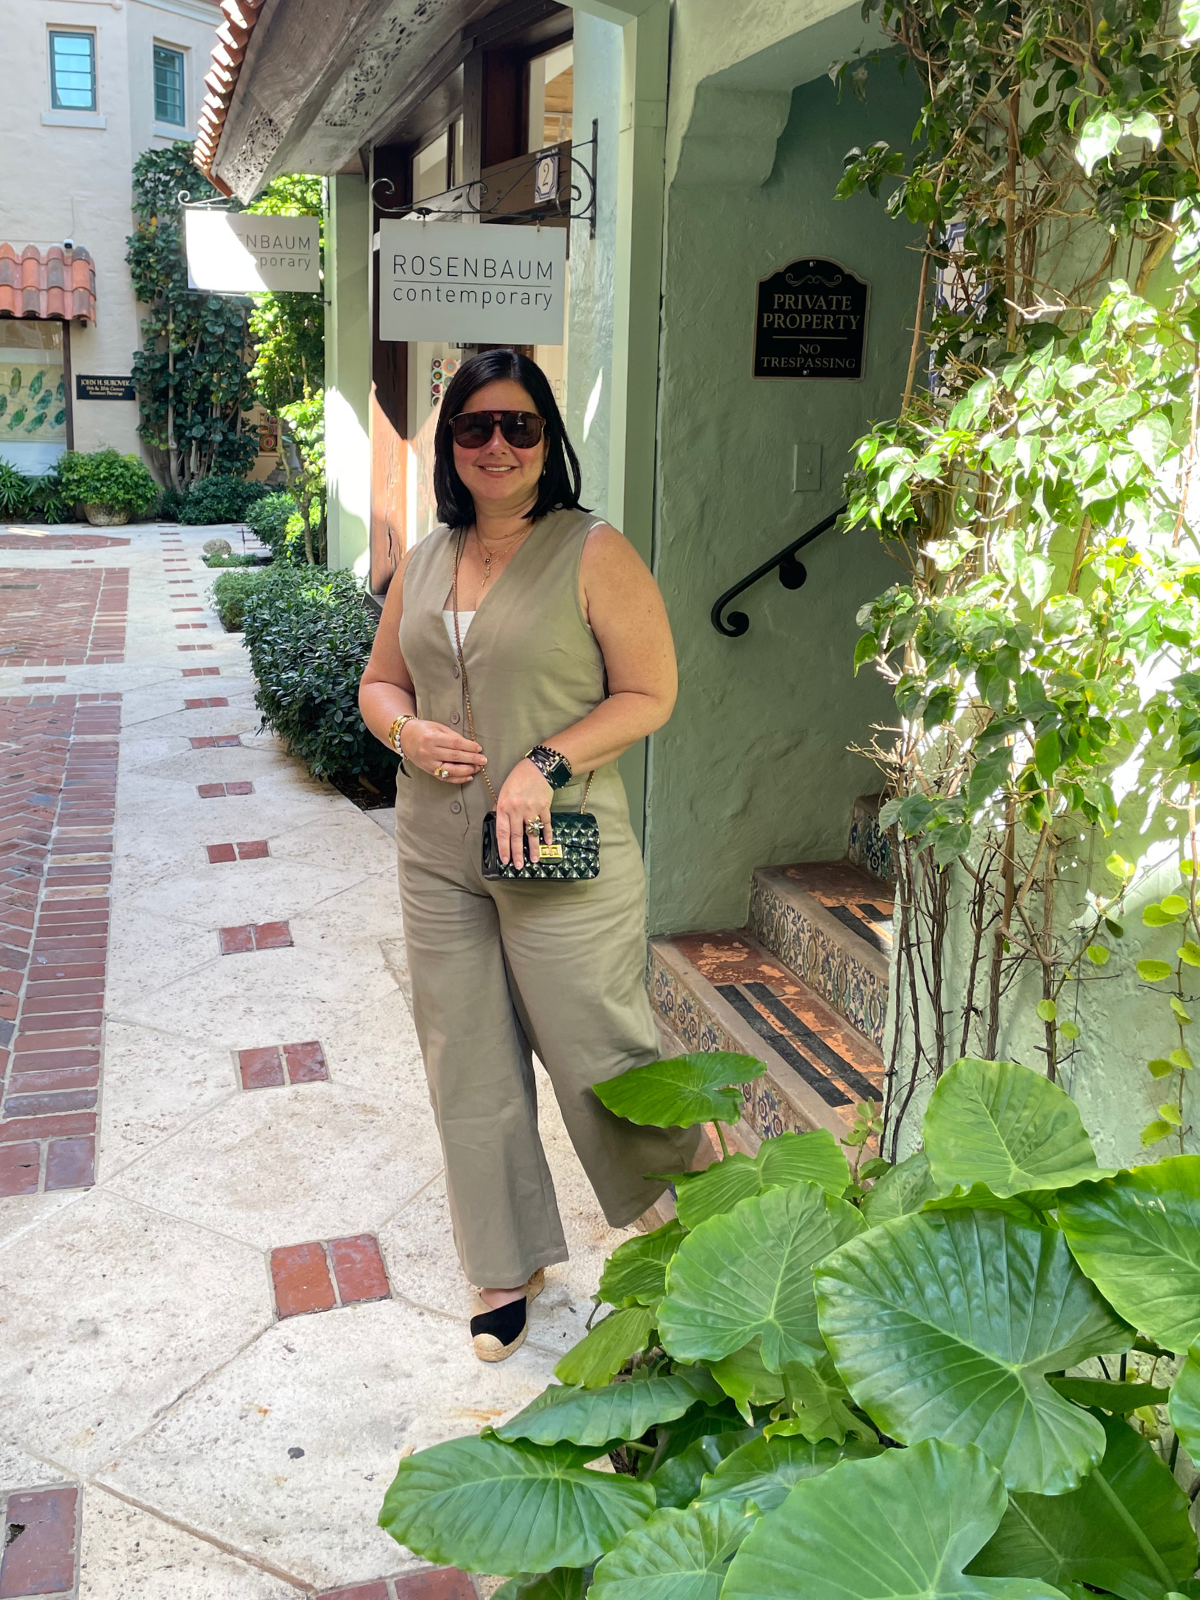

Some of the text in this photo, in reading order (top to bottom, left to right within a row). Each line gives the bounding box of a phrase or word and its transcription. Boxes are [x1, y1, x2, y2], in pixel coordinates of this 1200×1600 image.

[542, 163, 549, 186] 2
[236, 233, 311, 250] NBAUM
[260, 256, 311, 271] porary
[393, 254, 553, 280] ROSENBAUM
[393, 286, 553, 311] contemporary
[773, 293, 851, 310] PRIVATE
[763, 313, 859, 329] PROPERTY
[799, 344, 820, 354] NO
[761, 357, 855, 368] TRESPASSING
